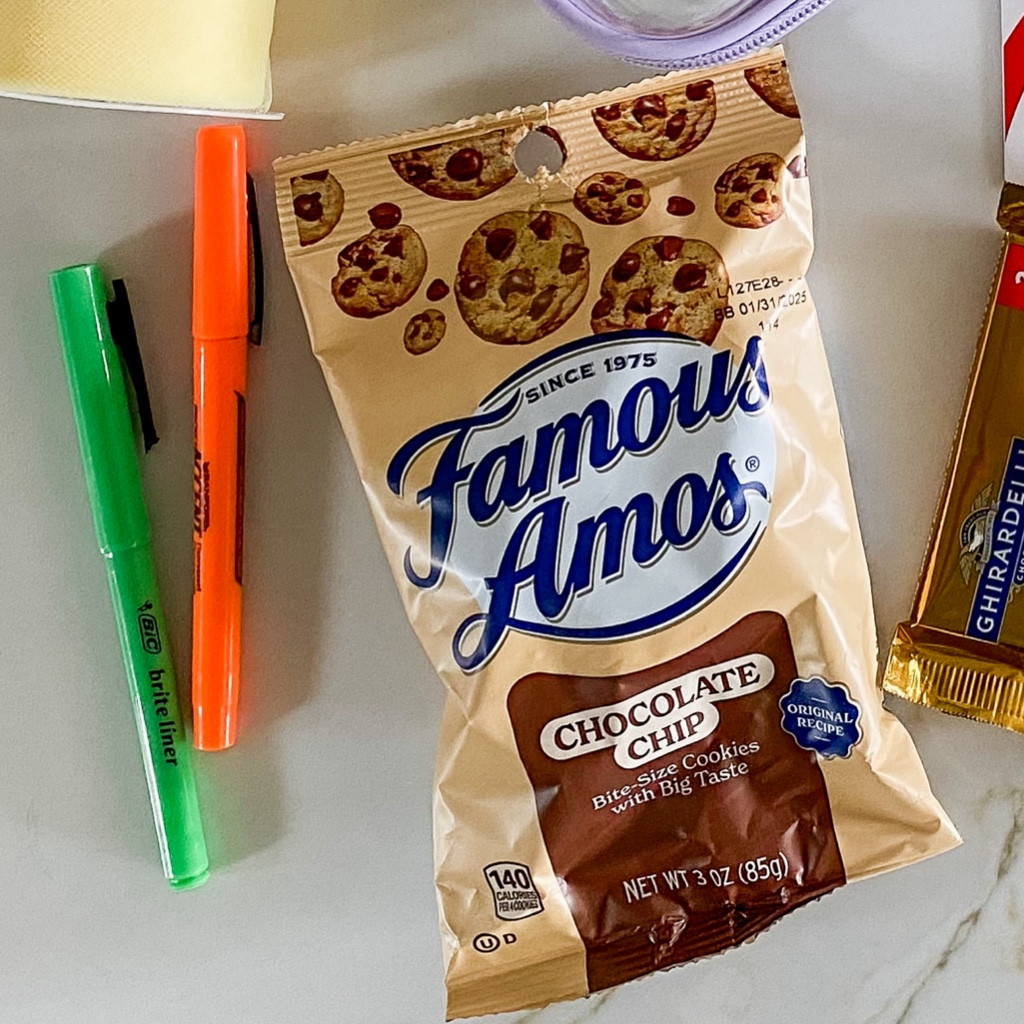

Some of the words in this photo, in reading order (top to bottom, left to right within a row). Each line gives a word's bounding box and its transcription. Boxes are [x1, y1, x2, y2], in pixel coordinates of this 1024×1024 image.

[713, 305, 735, 319] BB
[738, 290, 807, 315] 01/31/2025
[525, 363, 596, 404] SINCE
[603, 352, 658, 373] 1975
[386, 334, 770, 590] Famous
[452, 451, 767, 671] Amos
[148, 669, 171, 718] brite
[554, 661, 761, 750] CHOCOLATE
[787, 703, 854, 724] ORIGINAL
[158, 720, 178, 767] liner
[627, 711, 705, 760] CHIP
[797, 716, 845, 737] RECIPE
[591, 763, 679, 811] Bite-Size
[682, 741, 761, 770] Cookies
[611, 788, 656, 815] with
[659, 776, 693, 796] Big
[693, 762, 750, 788] Taste
[488, 868, 530, 889] 140
[496, 890, 538, 901] CALORIES
[622, 874, 659, 904] NET
[662, 869, 690, 891] WT
[691, 869, 708, 886] 3
[709, 866, 735, 887] OZ
[738, 851, 789, 885] (85g)
[499, 901, 509, 912] PER
